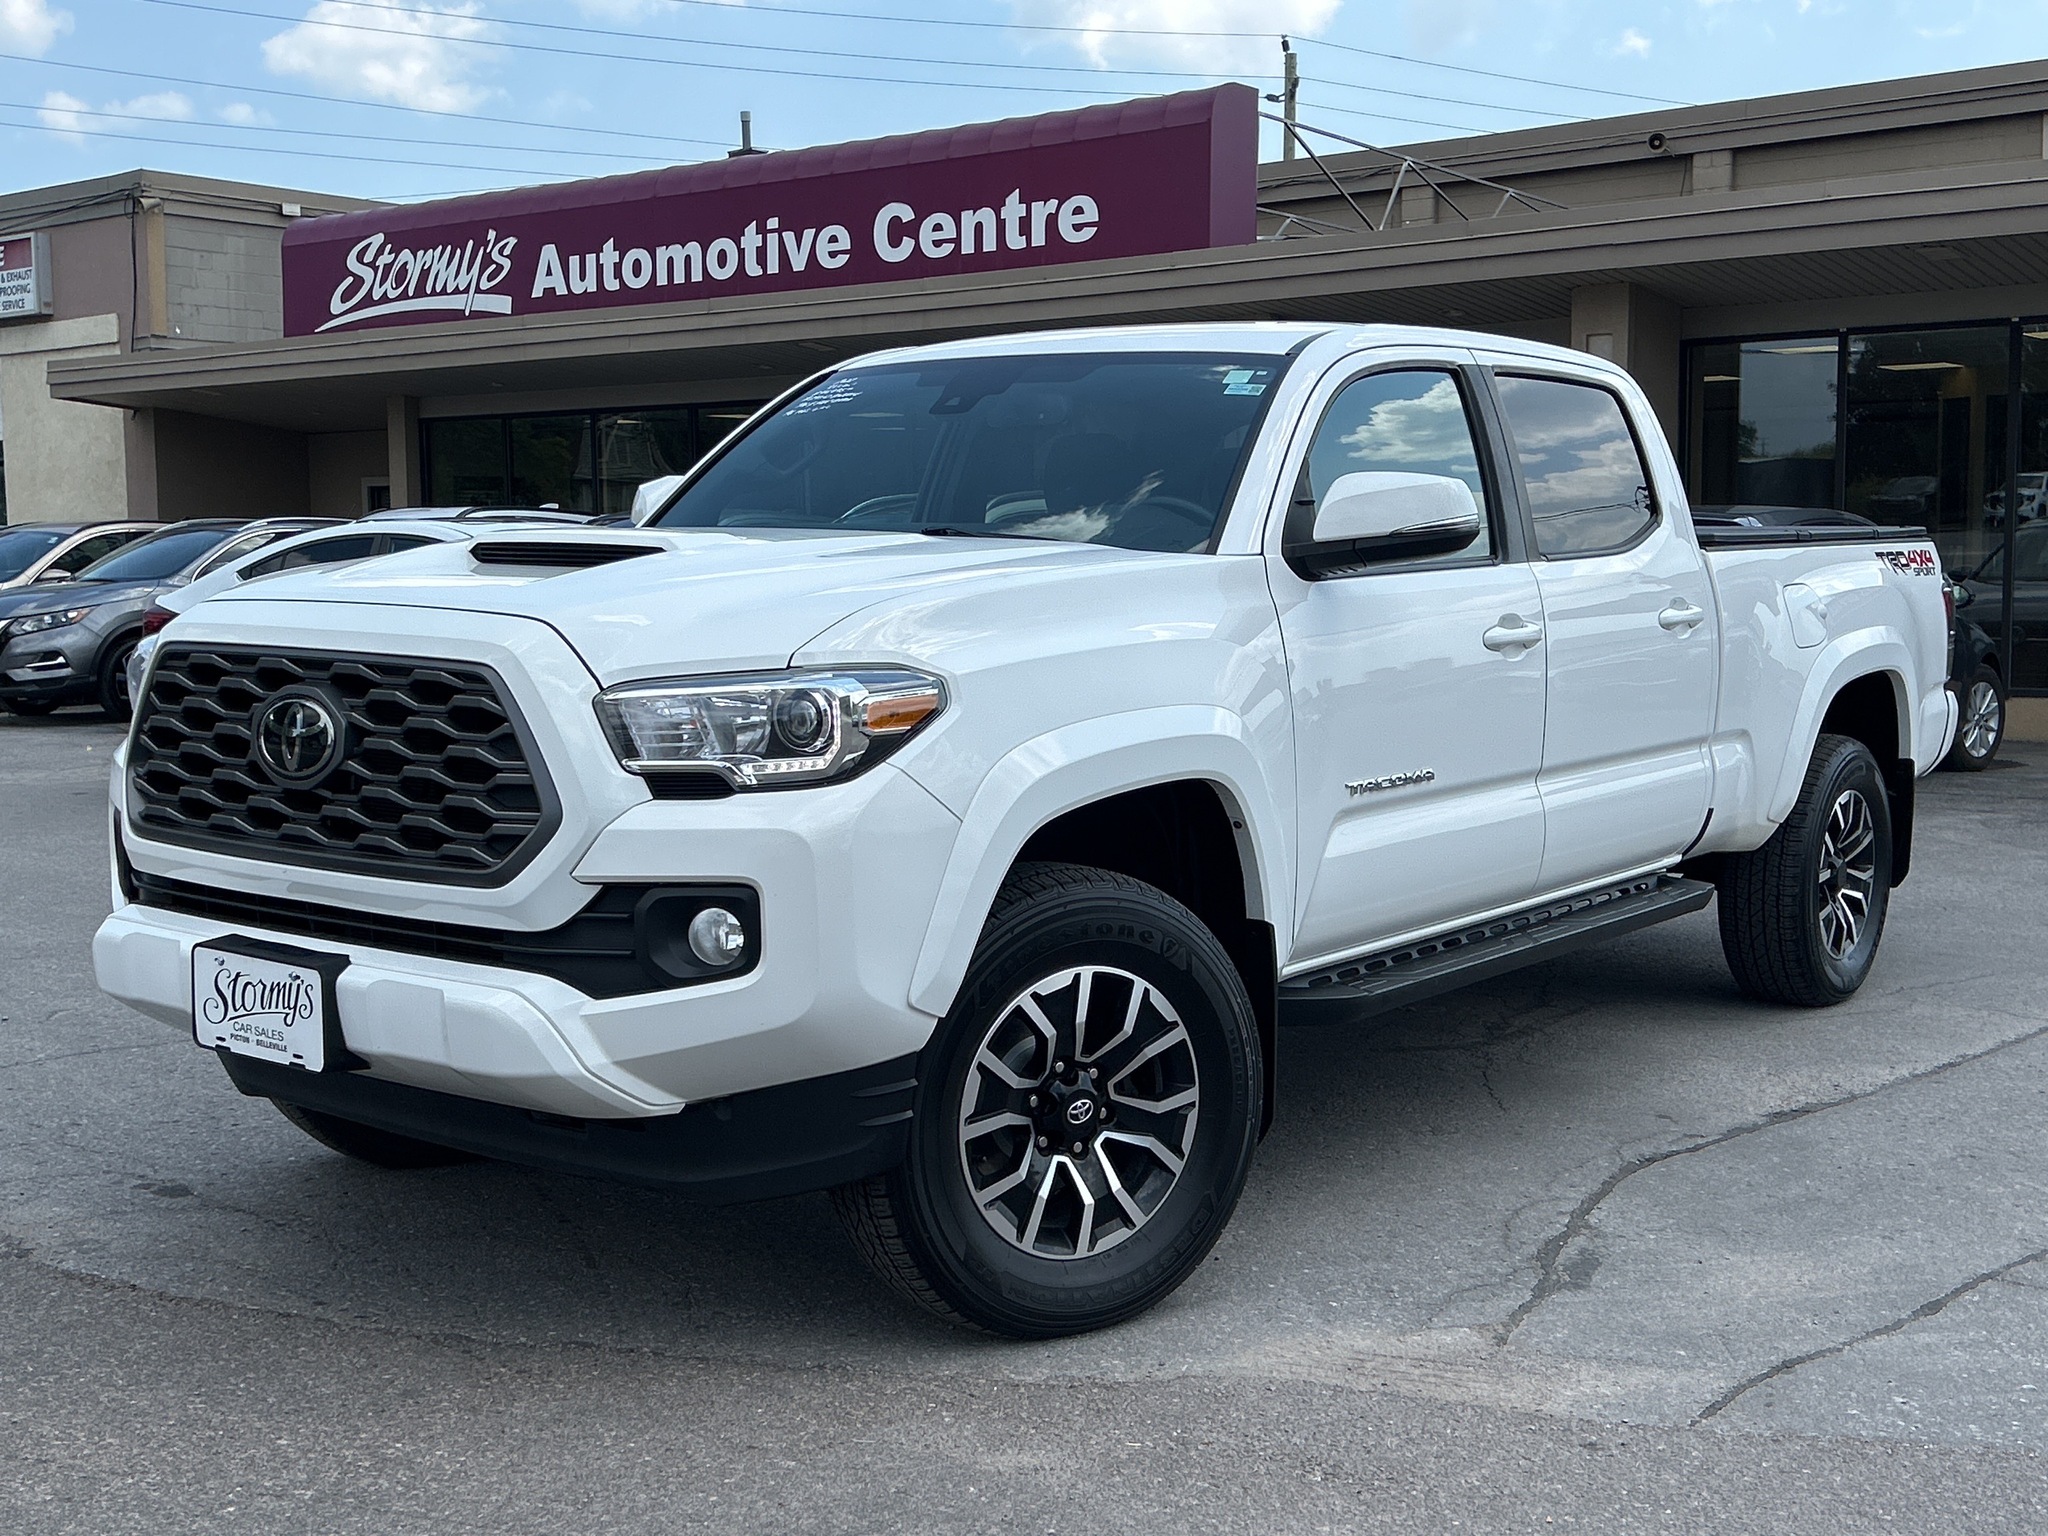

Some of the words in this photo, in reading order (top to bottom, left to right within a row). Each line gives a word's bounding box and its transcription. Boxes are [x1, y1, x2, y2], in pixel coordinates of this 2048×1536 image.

[329, 229, 518, 317] Stormy's
[531, 216, 852, 299] Automotive
[873, 188, 1100, 263] Centre
[7, 268, 33, 283] EXHAUST
[2, 299, 26, 311] SERVICE
[1875, 551, 1912, 576] TRD
[1913, 567, 1936, 577] SPORT
[1345, 768, 1435, 797] TACOMA
[203, 968, 314, 1027] Stormy's
[233, 1021, 253, 1034] CAR
[254, 1025, 284, 1042] SALES
[256, 1038, 288, 1053] BELLEVILLE
